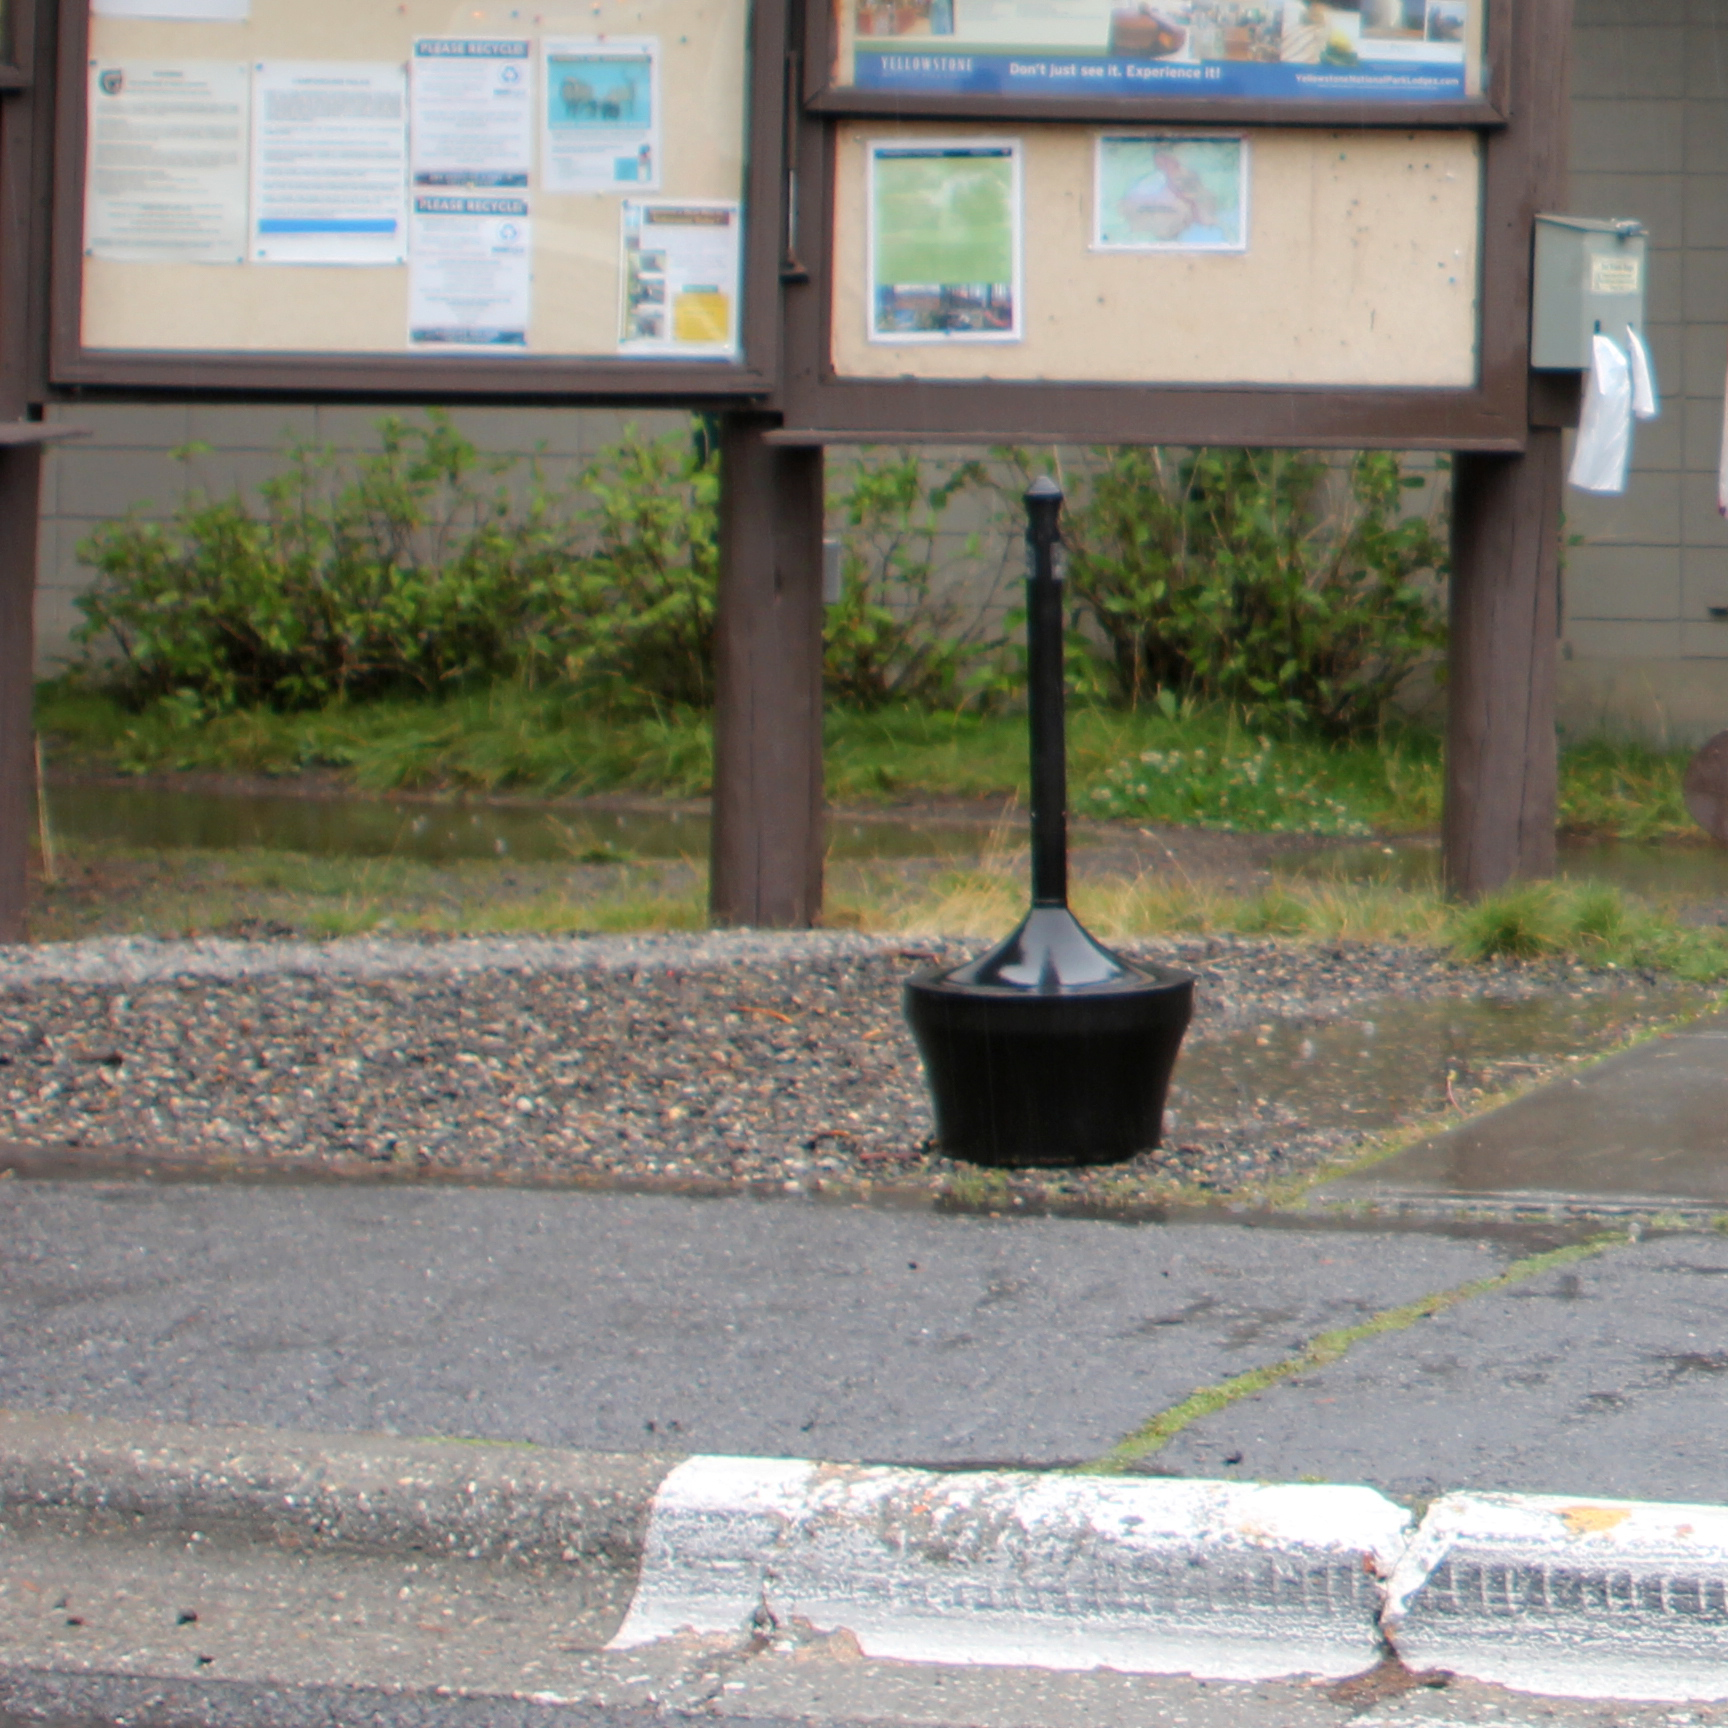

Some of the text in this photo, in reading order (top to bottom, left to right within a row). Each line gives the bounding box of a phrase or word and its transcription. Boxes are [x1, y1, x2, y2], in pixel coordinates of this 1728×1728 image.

[420, 42, 465, 54] PLEASE
[880, 56, 972, 72] YELLOWSTONE
[1009, 61, 1047, 76] Don't
[1049, 63, 1077, 78] just
[1080, 65, 1104, 77] see
[1107, 64, 1123, 77] it.
[1126, 65, 1202, 80] Experience
[419, 198, 463, 210] PLEASE
